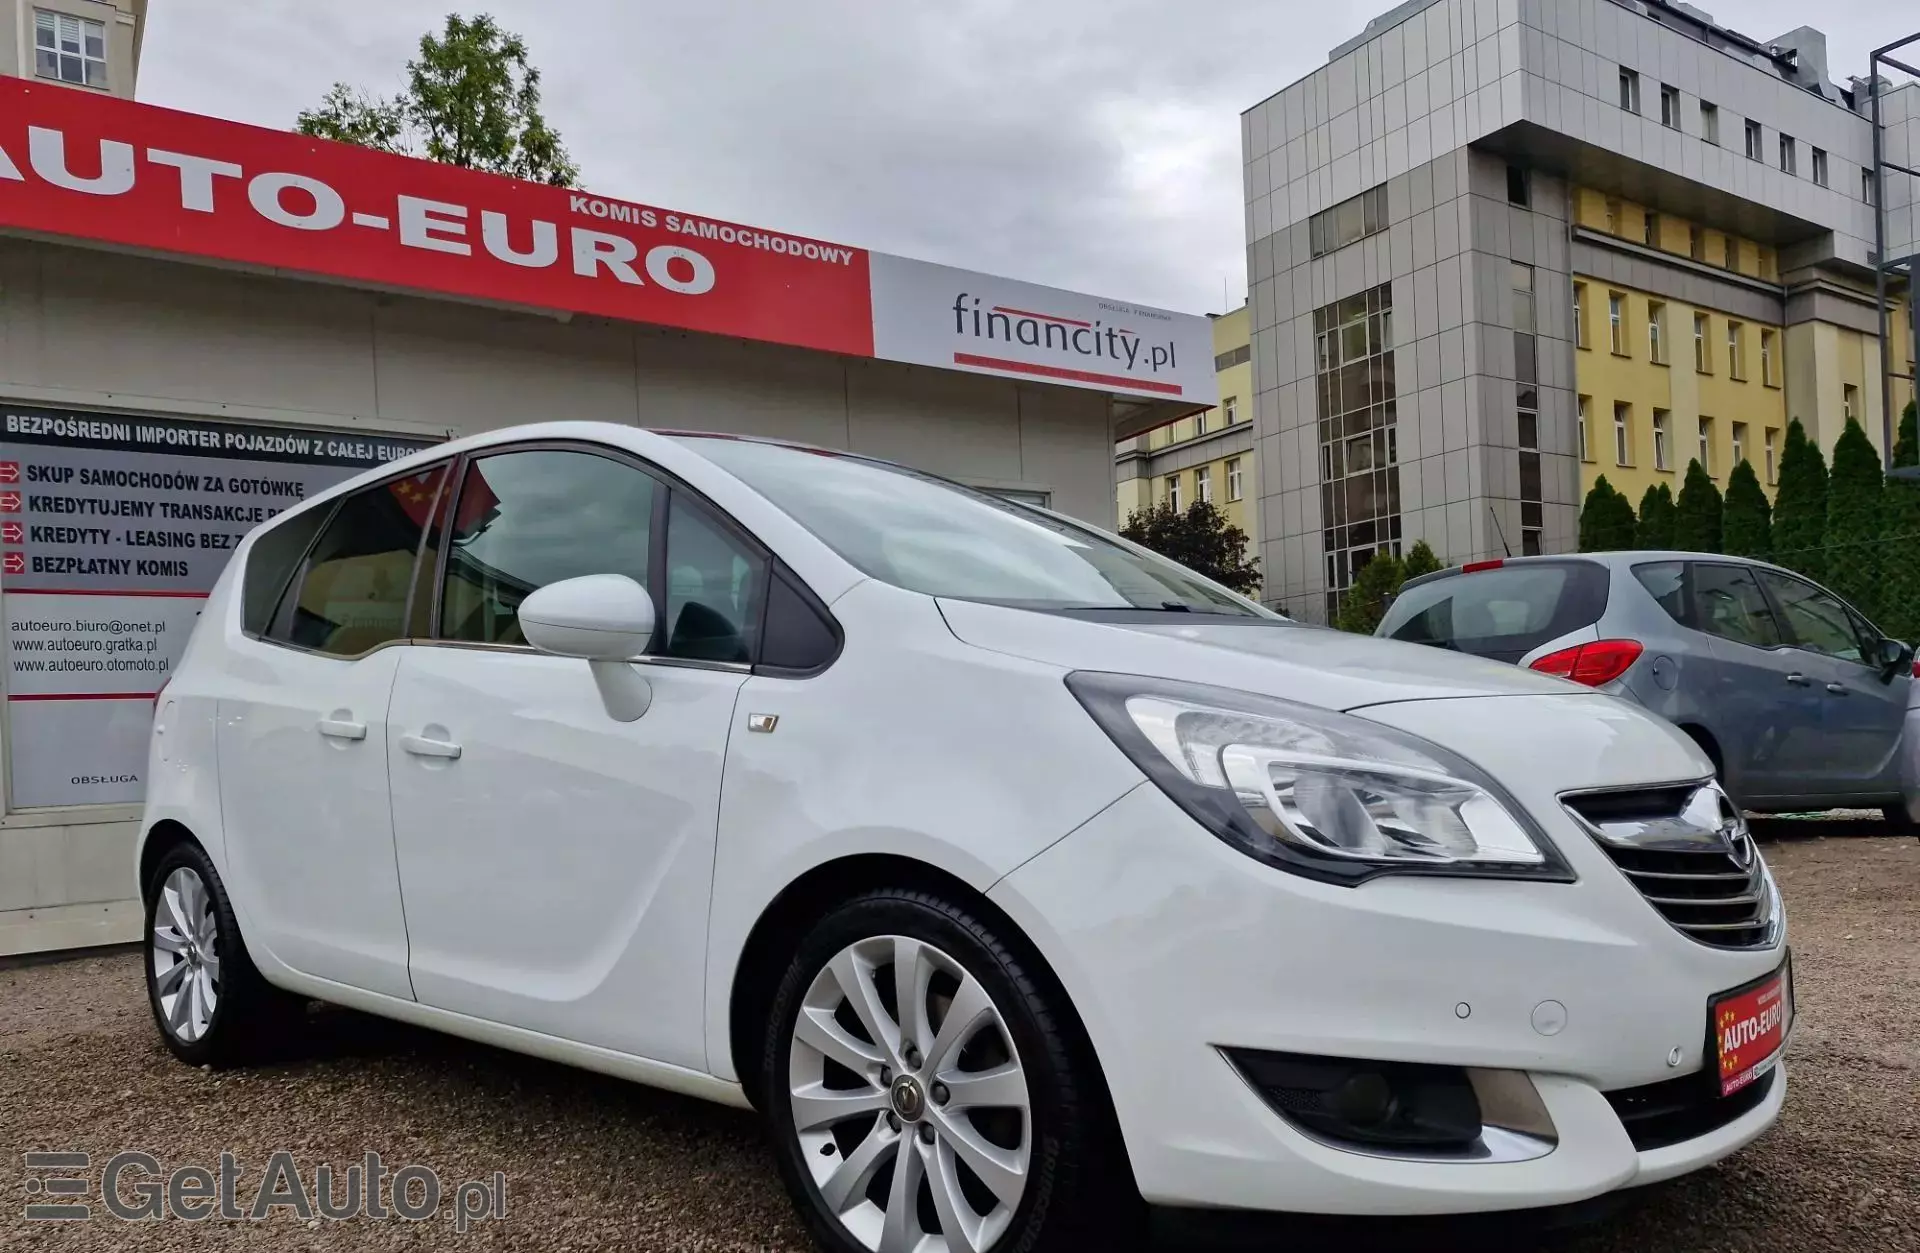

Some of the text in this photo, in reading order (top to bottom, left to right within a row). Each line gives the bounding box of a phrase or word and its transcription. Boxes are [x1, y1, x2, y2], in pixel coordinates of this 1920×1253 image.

[0, 125, 716, 295] UTO-EURO
[569, 195, 854, 266] KOMIS SAMOCHODOWY
[952, 292, 1177, 372] financity.pl
[6, 415, 131, 442] BEZPOŚREDNI
[136, 425, 221, 448] IMPORTER
[225, 432, 309, 456] POJAZDÓW
[313, 440, 324, 456] Z
[327, 441, 373, 460] CAŁEJ
[27, 465, 304, 501] SKUP SAMOCHODÓW ZA GOTÓWKĘ
[29, 496, 155, 518] KREDYTUJEMY
[160, 502, 263, 523] TRANSAKCJE
[30, 525, 111, 545] KREDYTY
[126, 530, 196, 549] LEASING
[200, 533, 231, 549] BEZ
[32, 556, 189, 577] BEZPŁATNY KOMIS
[11, 619, 166, 635] autoeuro.biuro@onet.pl
[12, 637, 158, 655] www.autoeuro.gratka.pl
[13, 657, 169, 674] www.autoeuro.otomoto.pl
[71, 774, 138, 785] OBSŁUGA
[1723, 1000, 1781, 1054] AUTO-EURO
